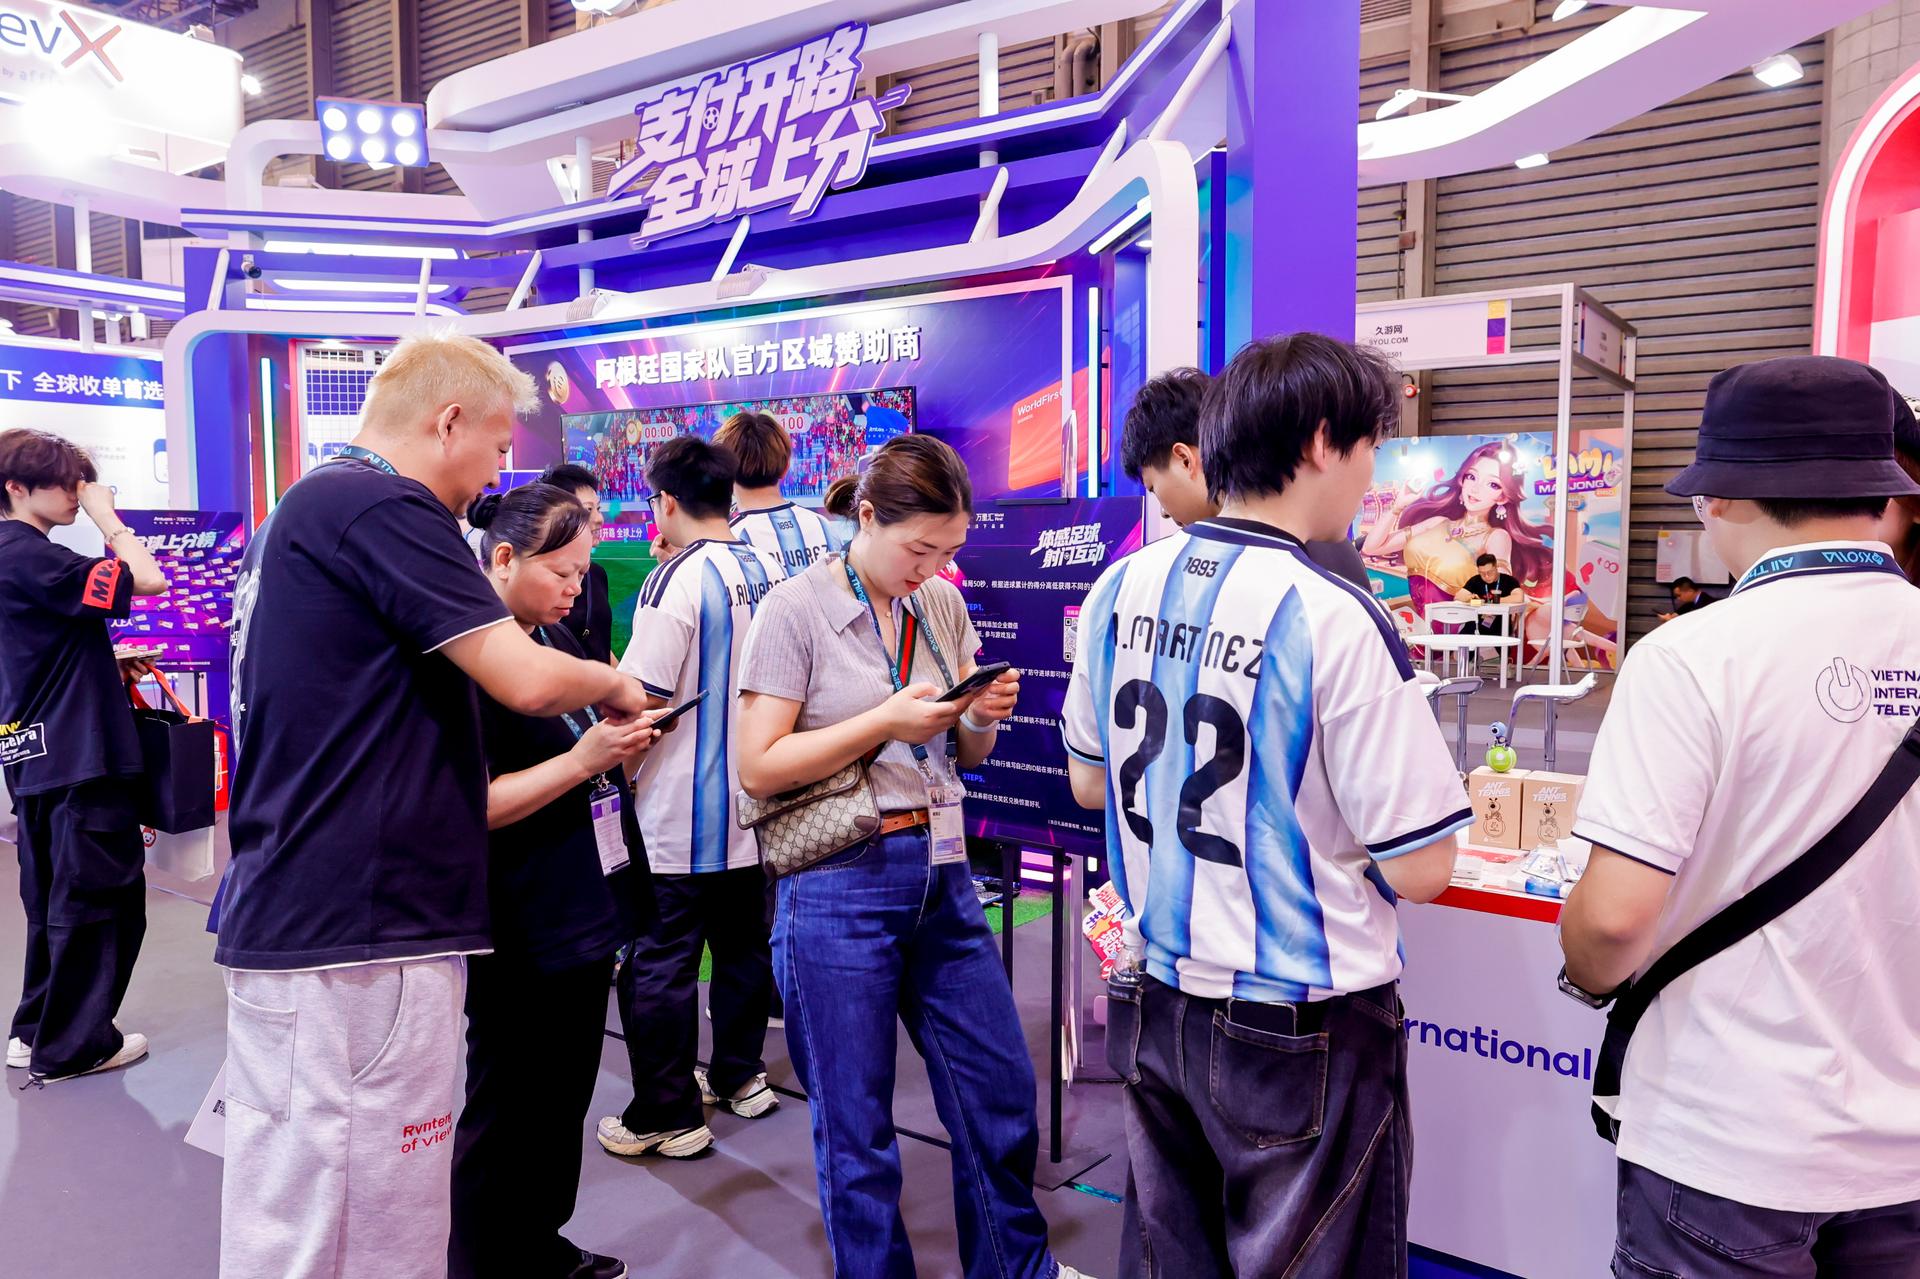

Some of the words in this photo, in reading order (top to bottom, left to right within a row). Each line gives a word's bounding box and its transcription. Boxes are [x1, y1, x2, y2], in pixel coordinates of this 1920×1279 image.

[607, 25, 865, 198] 支付开路
[640, 99, 884, 240] 全球上分
[595, 325, 922, 390] 阿根廷国家队官方区域赞助商
[33, 371, 164, 401] 全球收单首选
[644, 426, 673, 438] 00:00
[1538, 480, 1604, 494] MAJONG
[1030, 523, 1101, 556] 体感足球
[1182, 556, 1221, 578] 1893
[1874, 687, 1920, 699] INTER
[1114, 678, 1245, 868] 22
[401, 1137, 418, 1154] of
